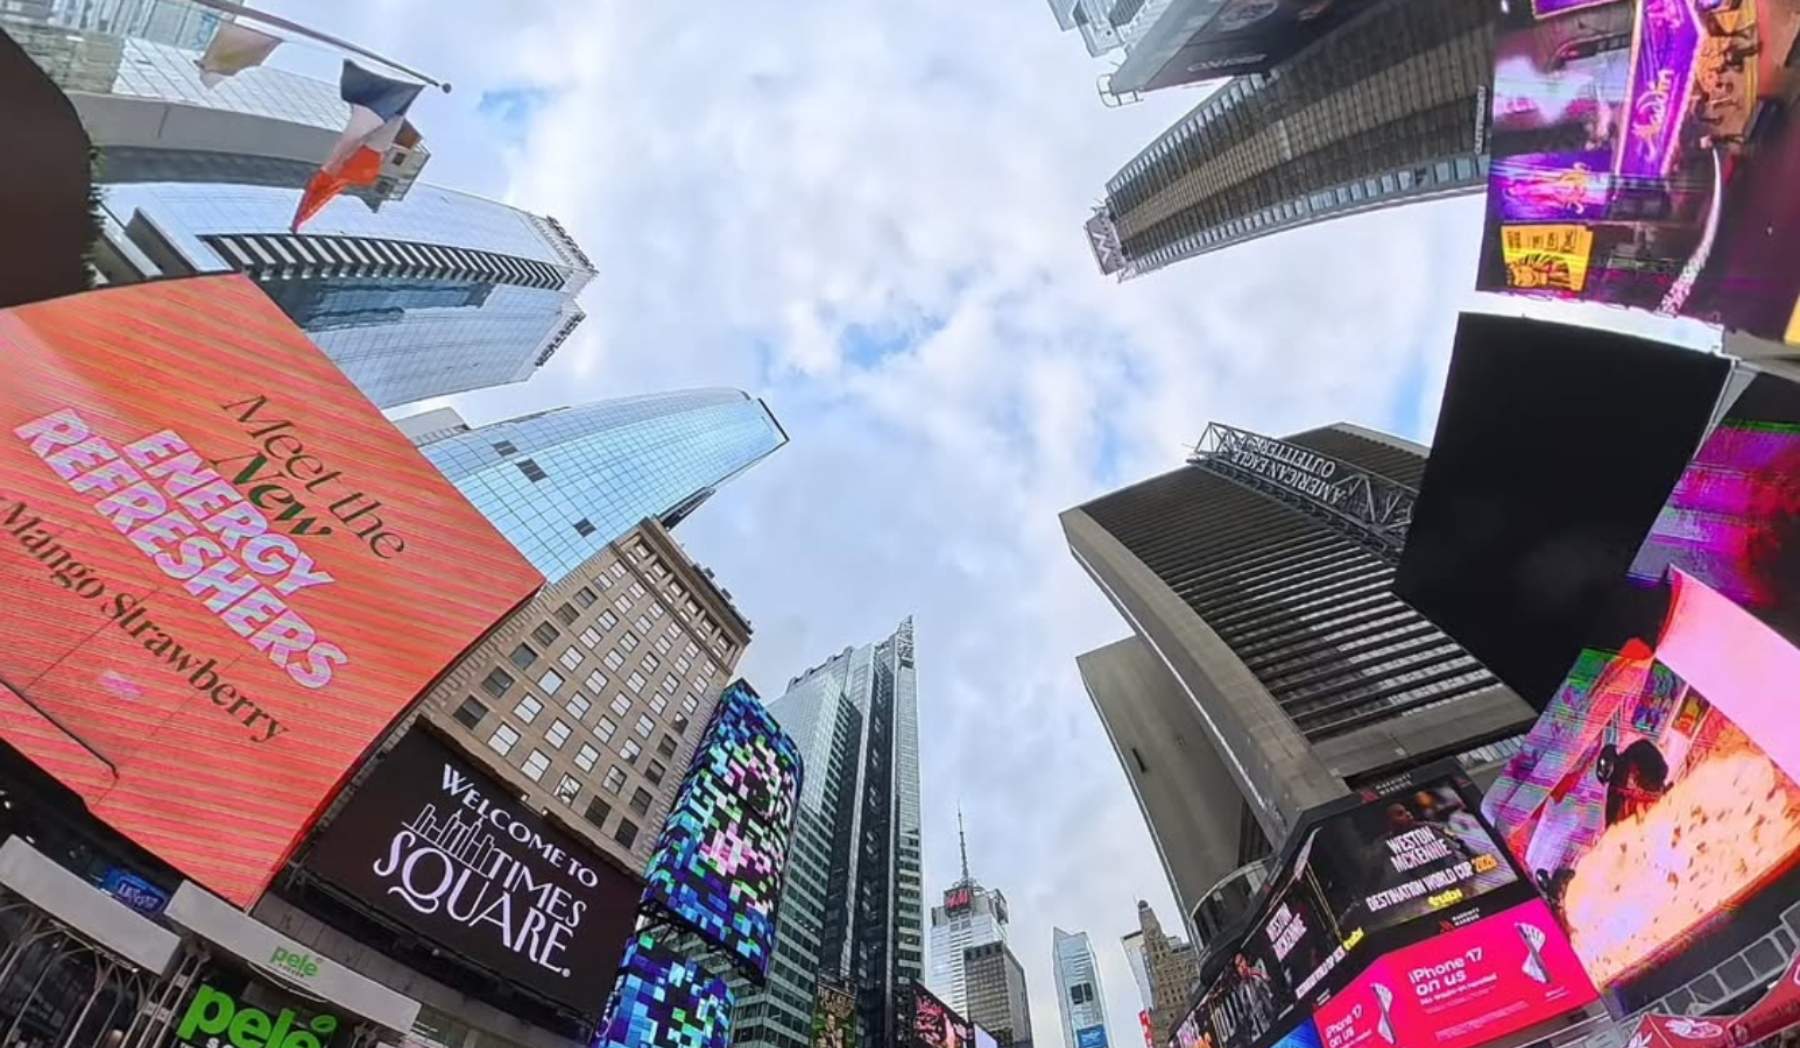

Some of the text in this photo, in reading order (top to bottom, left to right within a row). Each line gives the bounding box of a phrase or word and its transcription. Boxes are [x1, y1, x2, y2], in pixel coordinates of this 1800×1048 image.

[220, 394, 404, 559] Meet the
[1231, 450, 1347, 505] AMERICAN EAGLE
[1246, 437, 1336, 478] OUTFITTERS
[122, 428, 336, 597] ENERGY
[208, 451, 332, 535] New
[13, 407, 348, 689] REFRESHERS
[0, 500, 289, 743] Mango Strawberry
[442, 763, 599, 888] WELCOME TO
[1386, 825, 1436, 855] WESTON
[1391, 838, 1452, 872] MCKENNIE
[487, 847, 588, 928] TIMES
[1423, 869, 1457, 892] WORLD
[1454, 861, 1474, 880] CUP
[1408, 947, 1484, 984] iPhone 17
[1416, 981, 1441, 997] on
[1443, 970, 1468, 989] us
